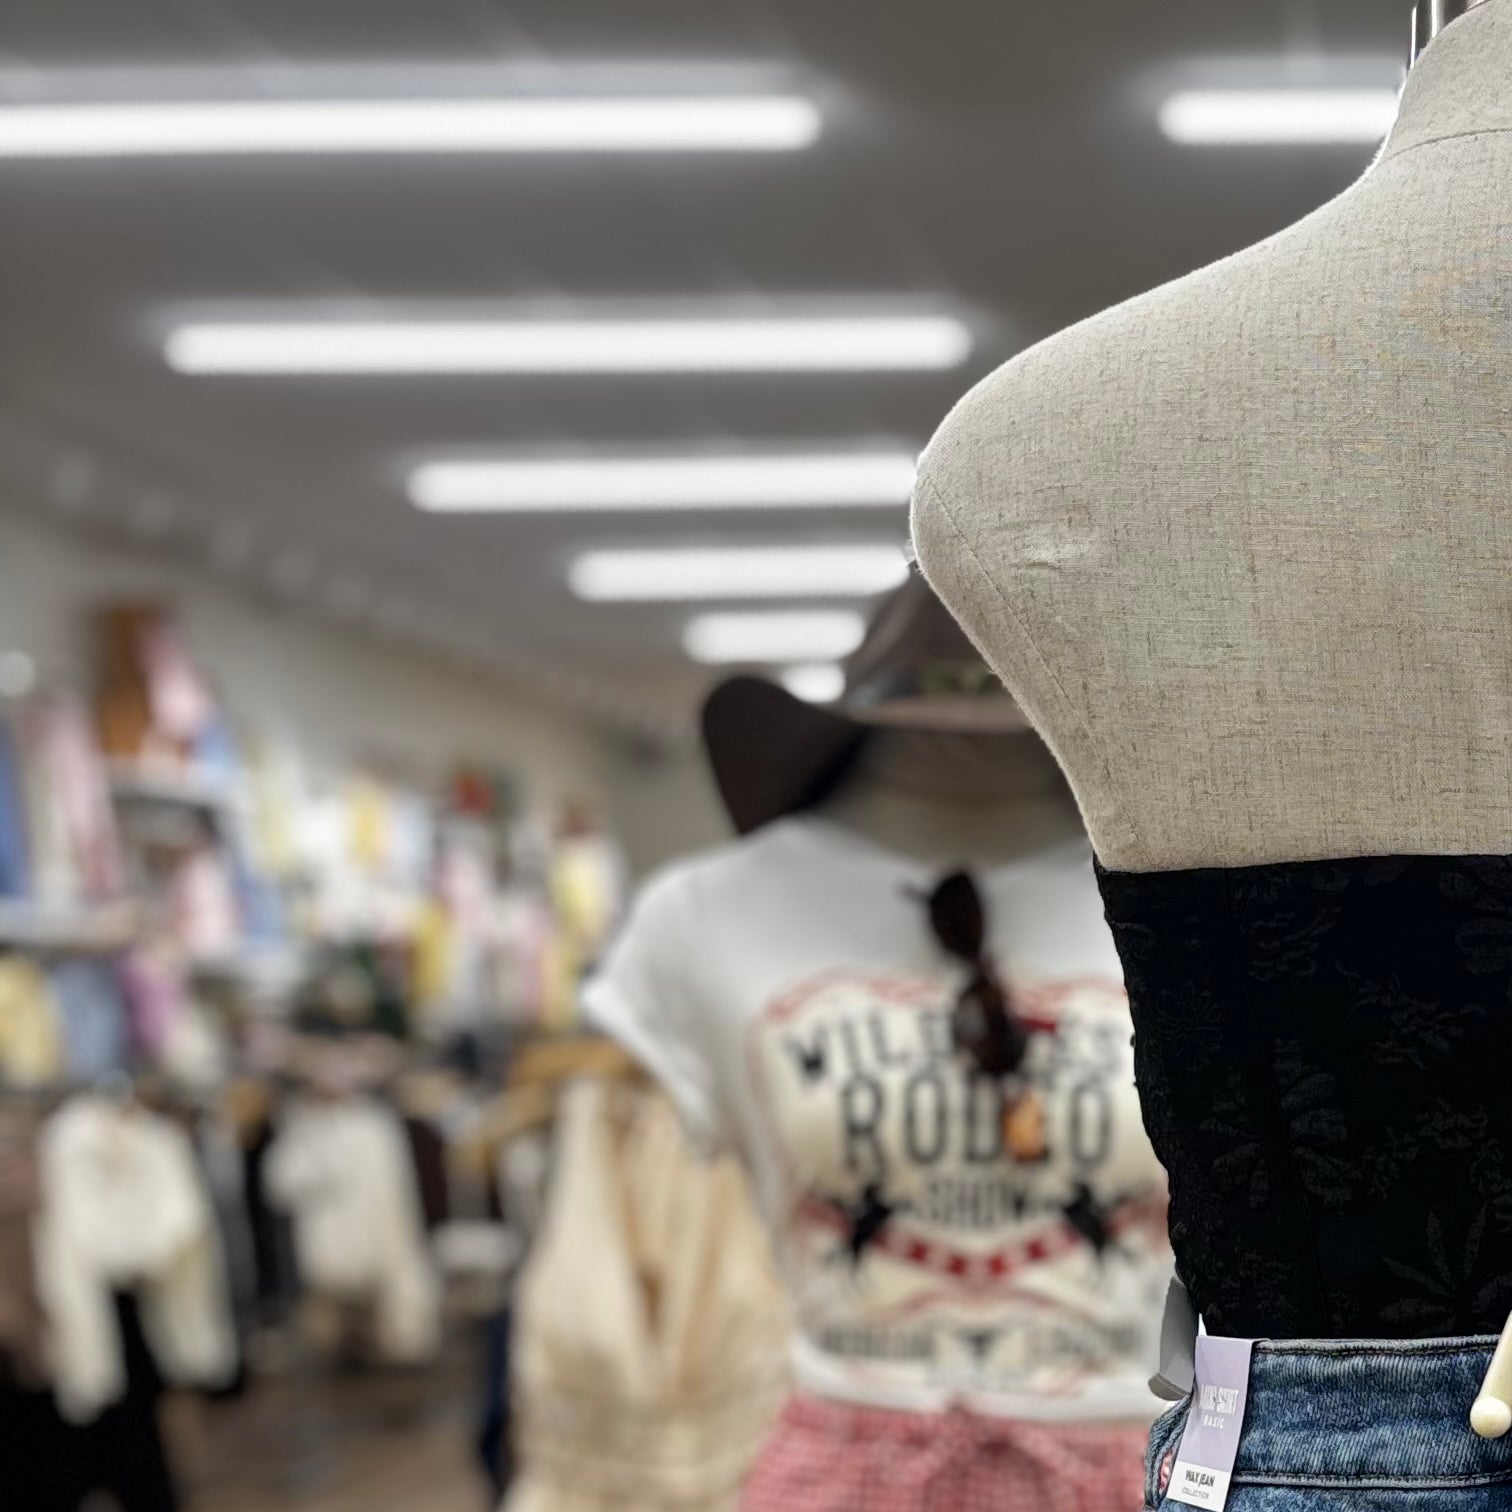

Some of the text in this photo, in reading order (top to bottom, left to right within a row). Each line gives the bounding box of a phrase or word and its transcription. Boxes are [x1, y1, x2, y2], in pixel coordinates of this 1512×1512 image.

[842, 1073, 1113, 1182] RODO
[1203, 1415, 1224, 1429] BASIC
[1185, 1470, 1216, 1488] WAX JEAN
[1182, 1487, 1209, 1499] COLLECTION
